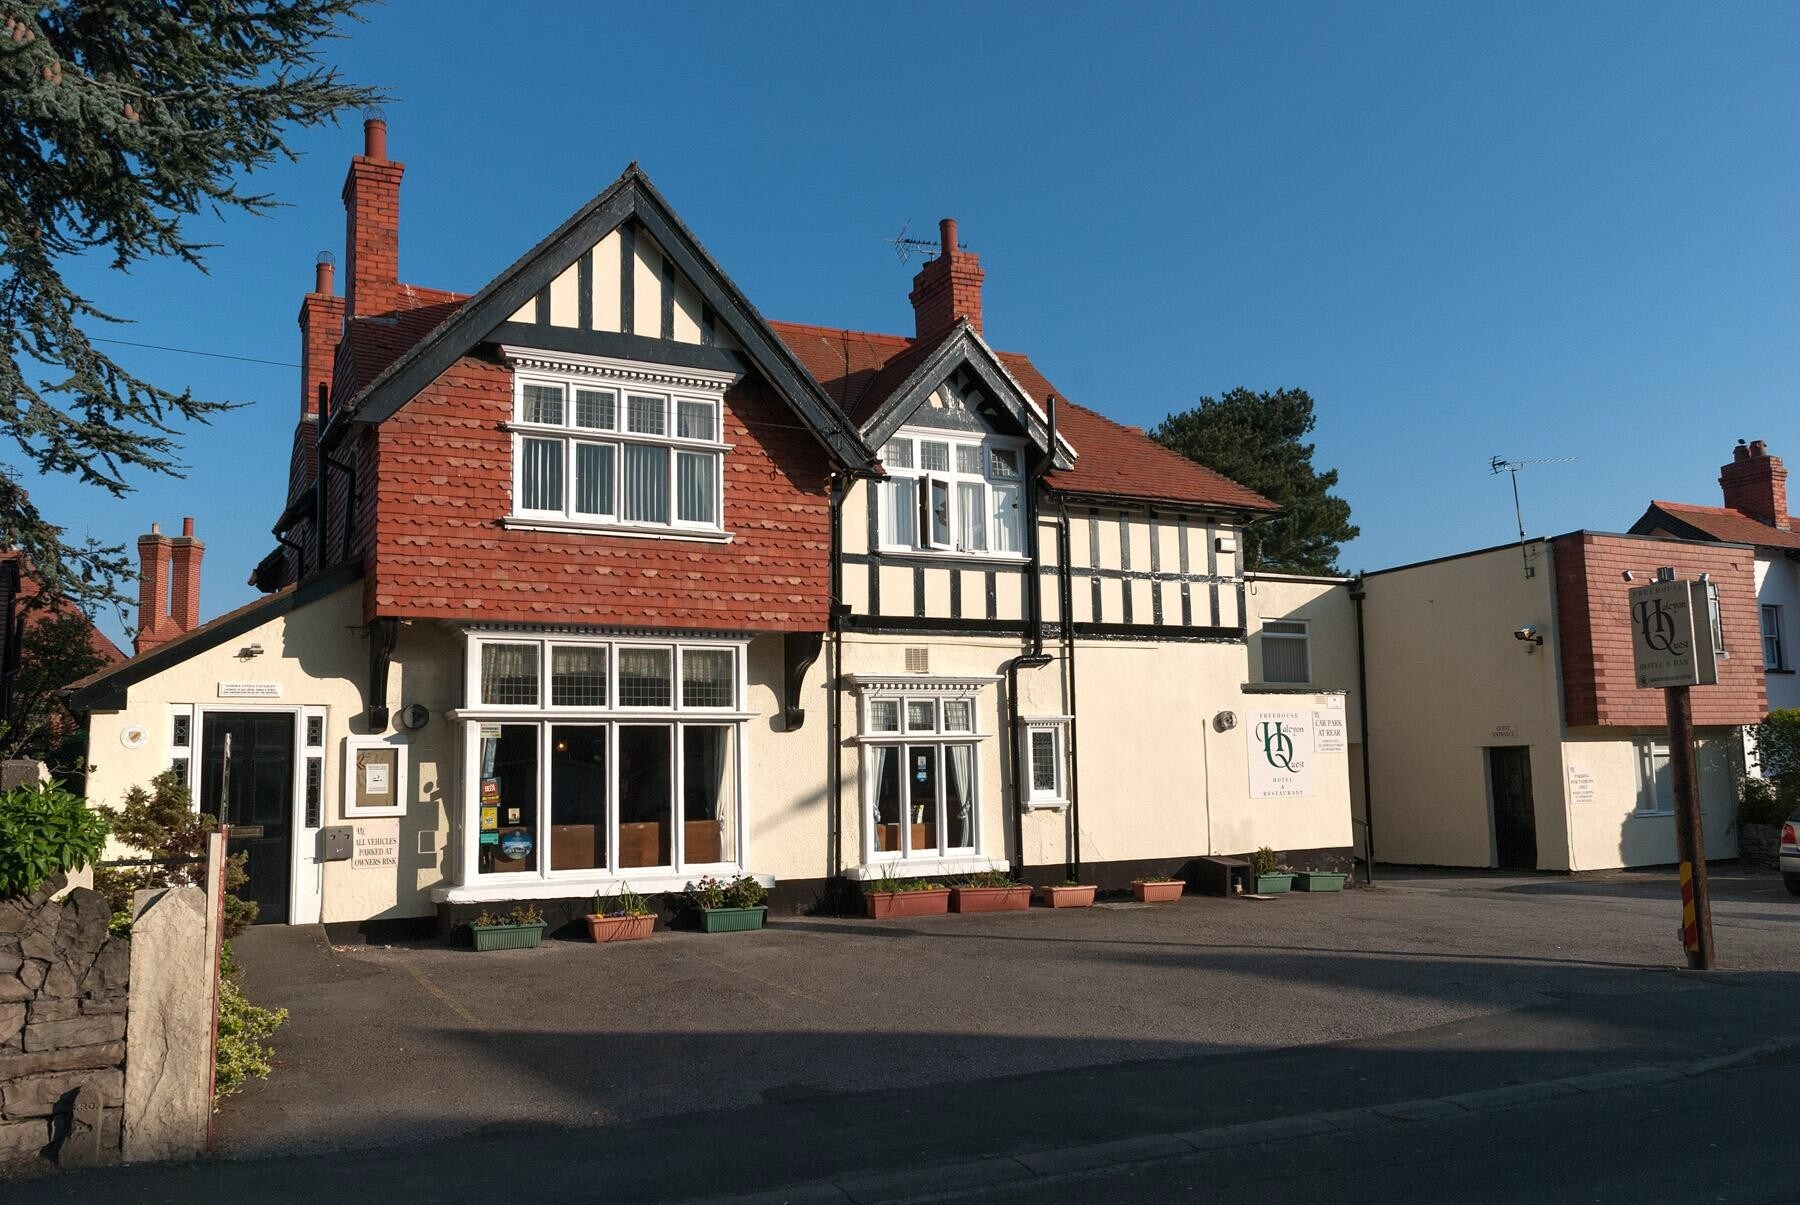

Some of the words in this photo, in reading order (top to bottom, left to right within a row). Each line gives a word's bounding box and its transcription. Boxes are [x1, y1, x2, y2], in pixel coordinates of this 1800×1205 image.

[1640, 662, 1664, 670] HOTEL
[1315, 719, 1327, 727] CAR
[1327, 719, 1343, 727] PARK
[1255, 721, 1304, 752] Halcyon
[1318, 729, 1325, 737] AT
[1326, 729, 1341, 737] REAR
[367, 837, 397, 846] VEHICLES
[359, 848, 384, 856] PARKED
[354, 858, 381, 866] OWNERS
[382, 857, 397, 865] RISK
